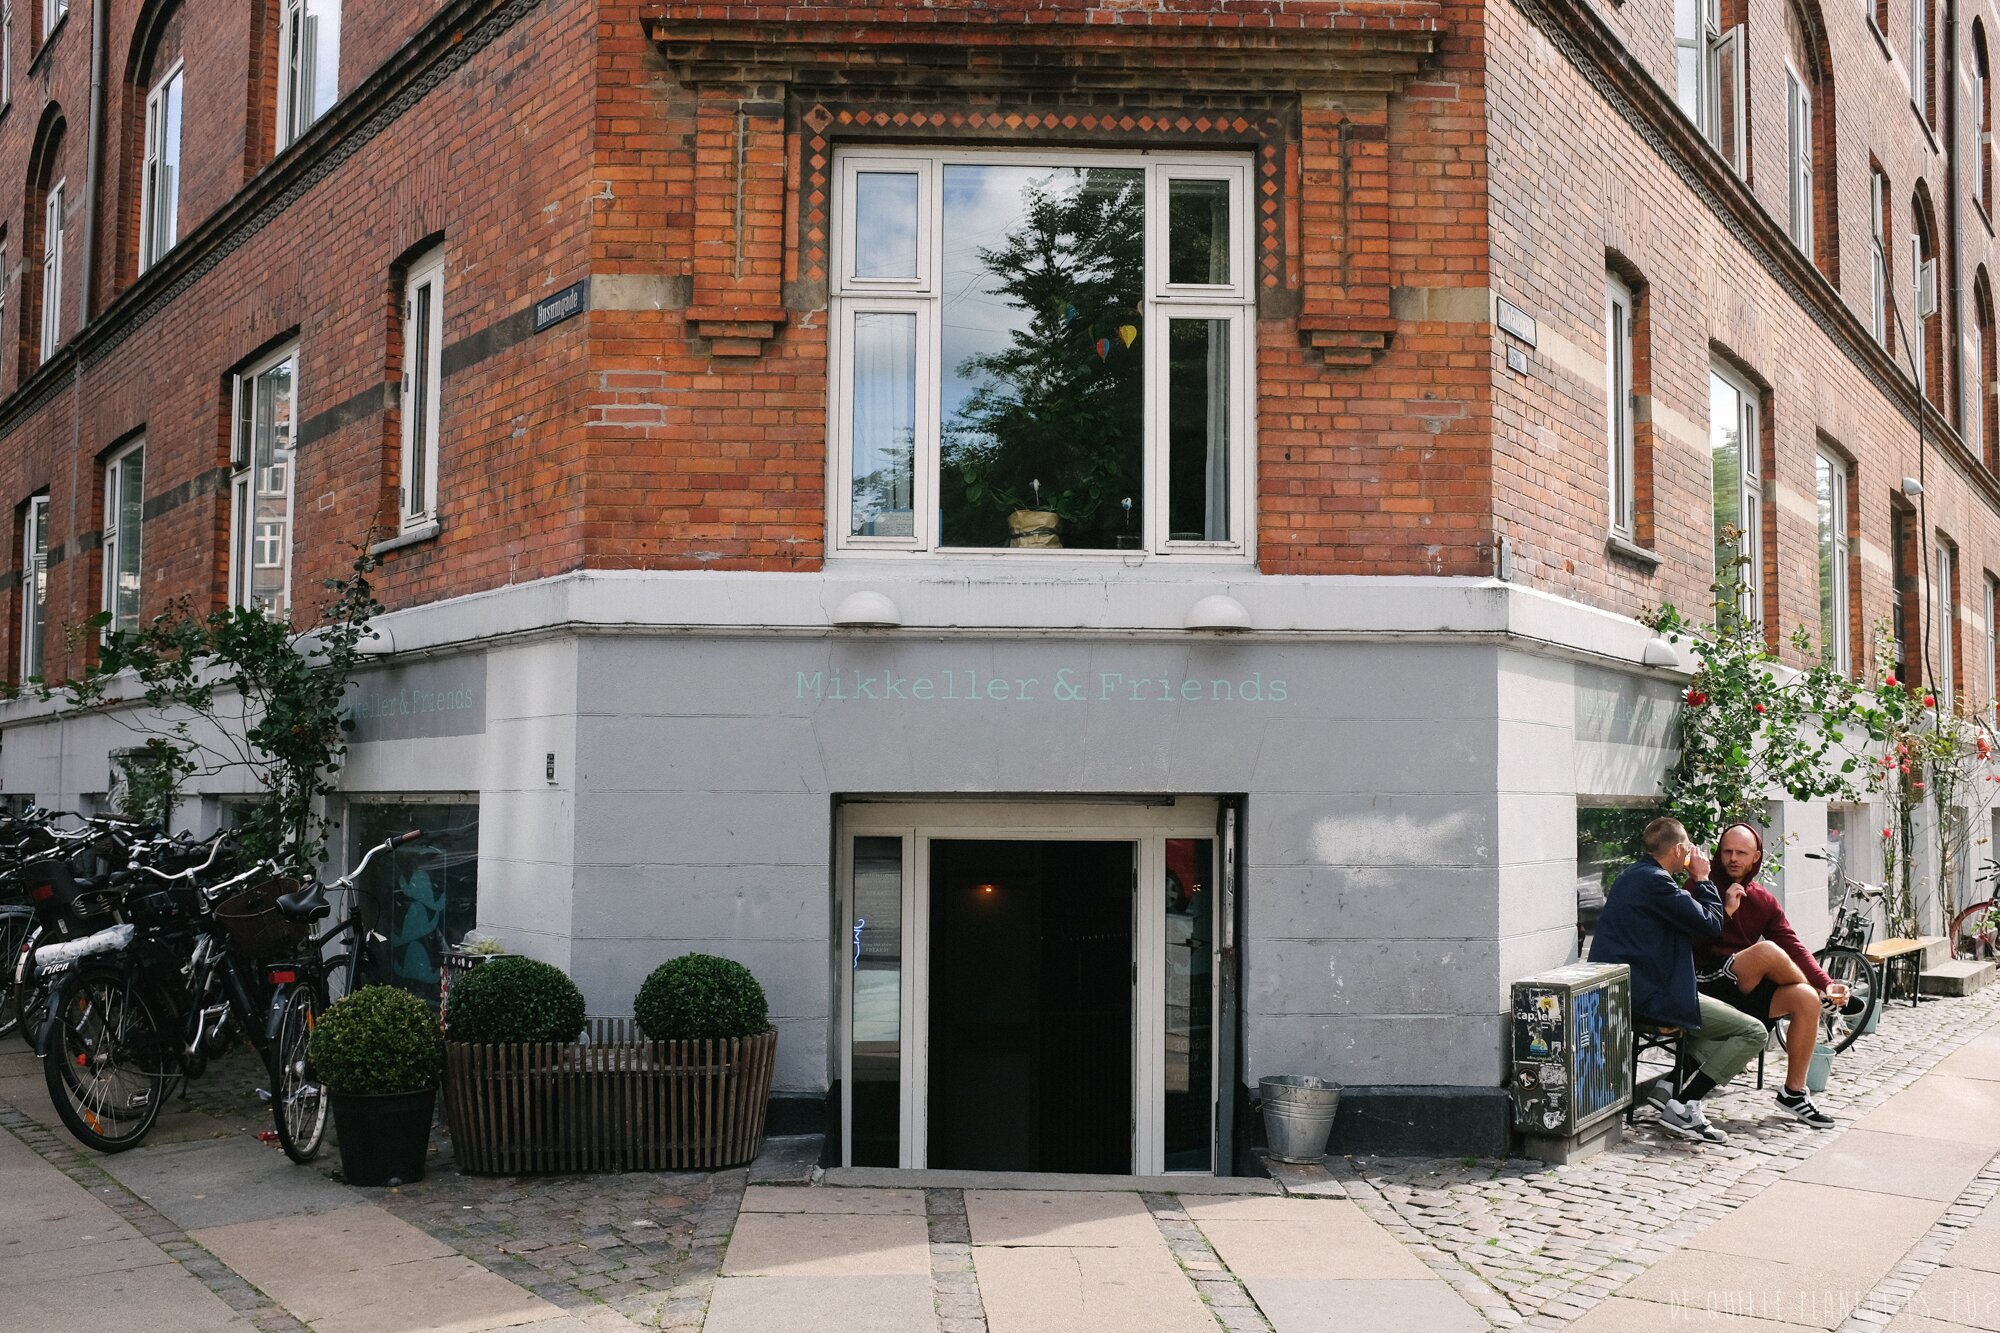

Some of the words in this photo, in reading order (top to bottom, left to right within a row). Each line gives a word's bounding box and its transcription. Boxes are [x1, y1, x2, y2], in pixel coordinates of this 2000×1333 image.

[537, 289, 578, 326] Husumgade
[412, 682, 473, 714] Friends
[796, 667, 1039, 700] Mikkeller
[1054, 667, 1087, 700] &
[1100, 670, 1287, 701] Friends
